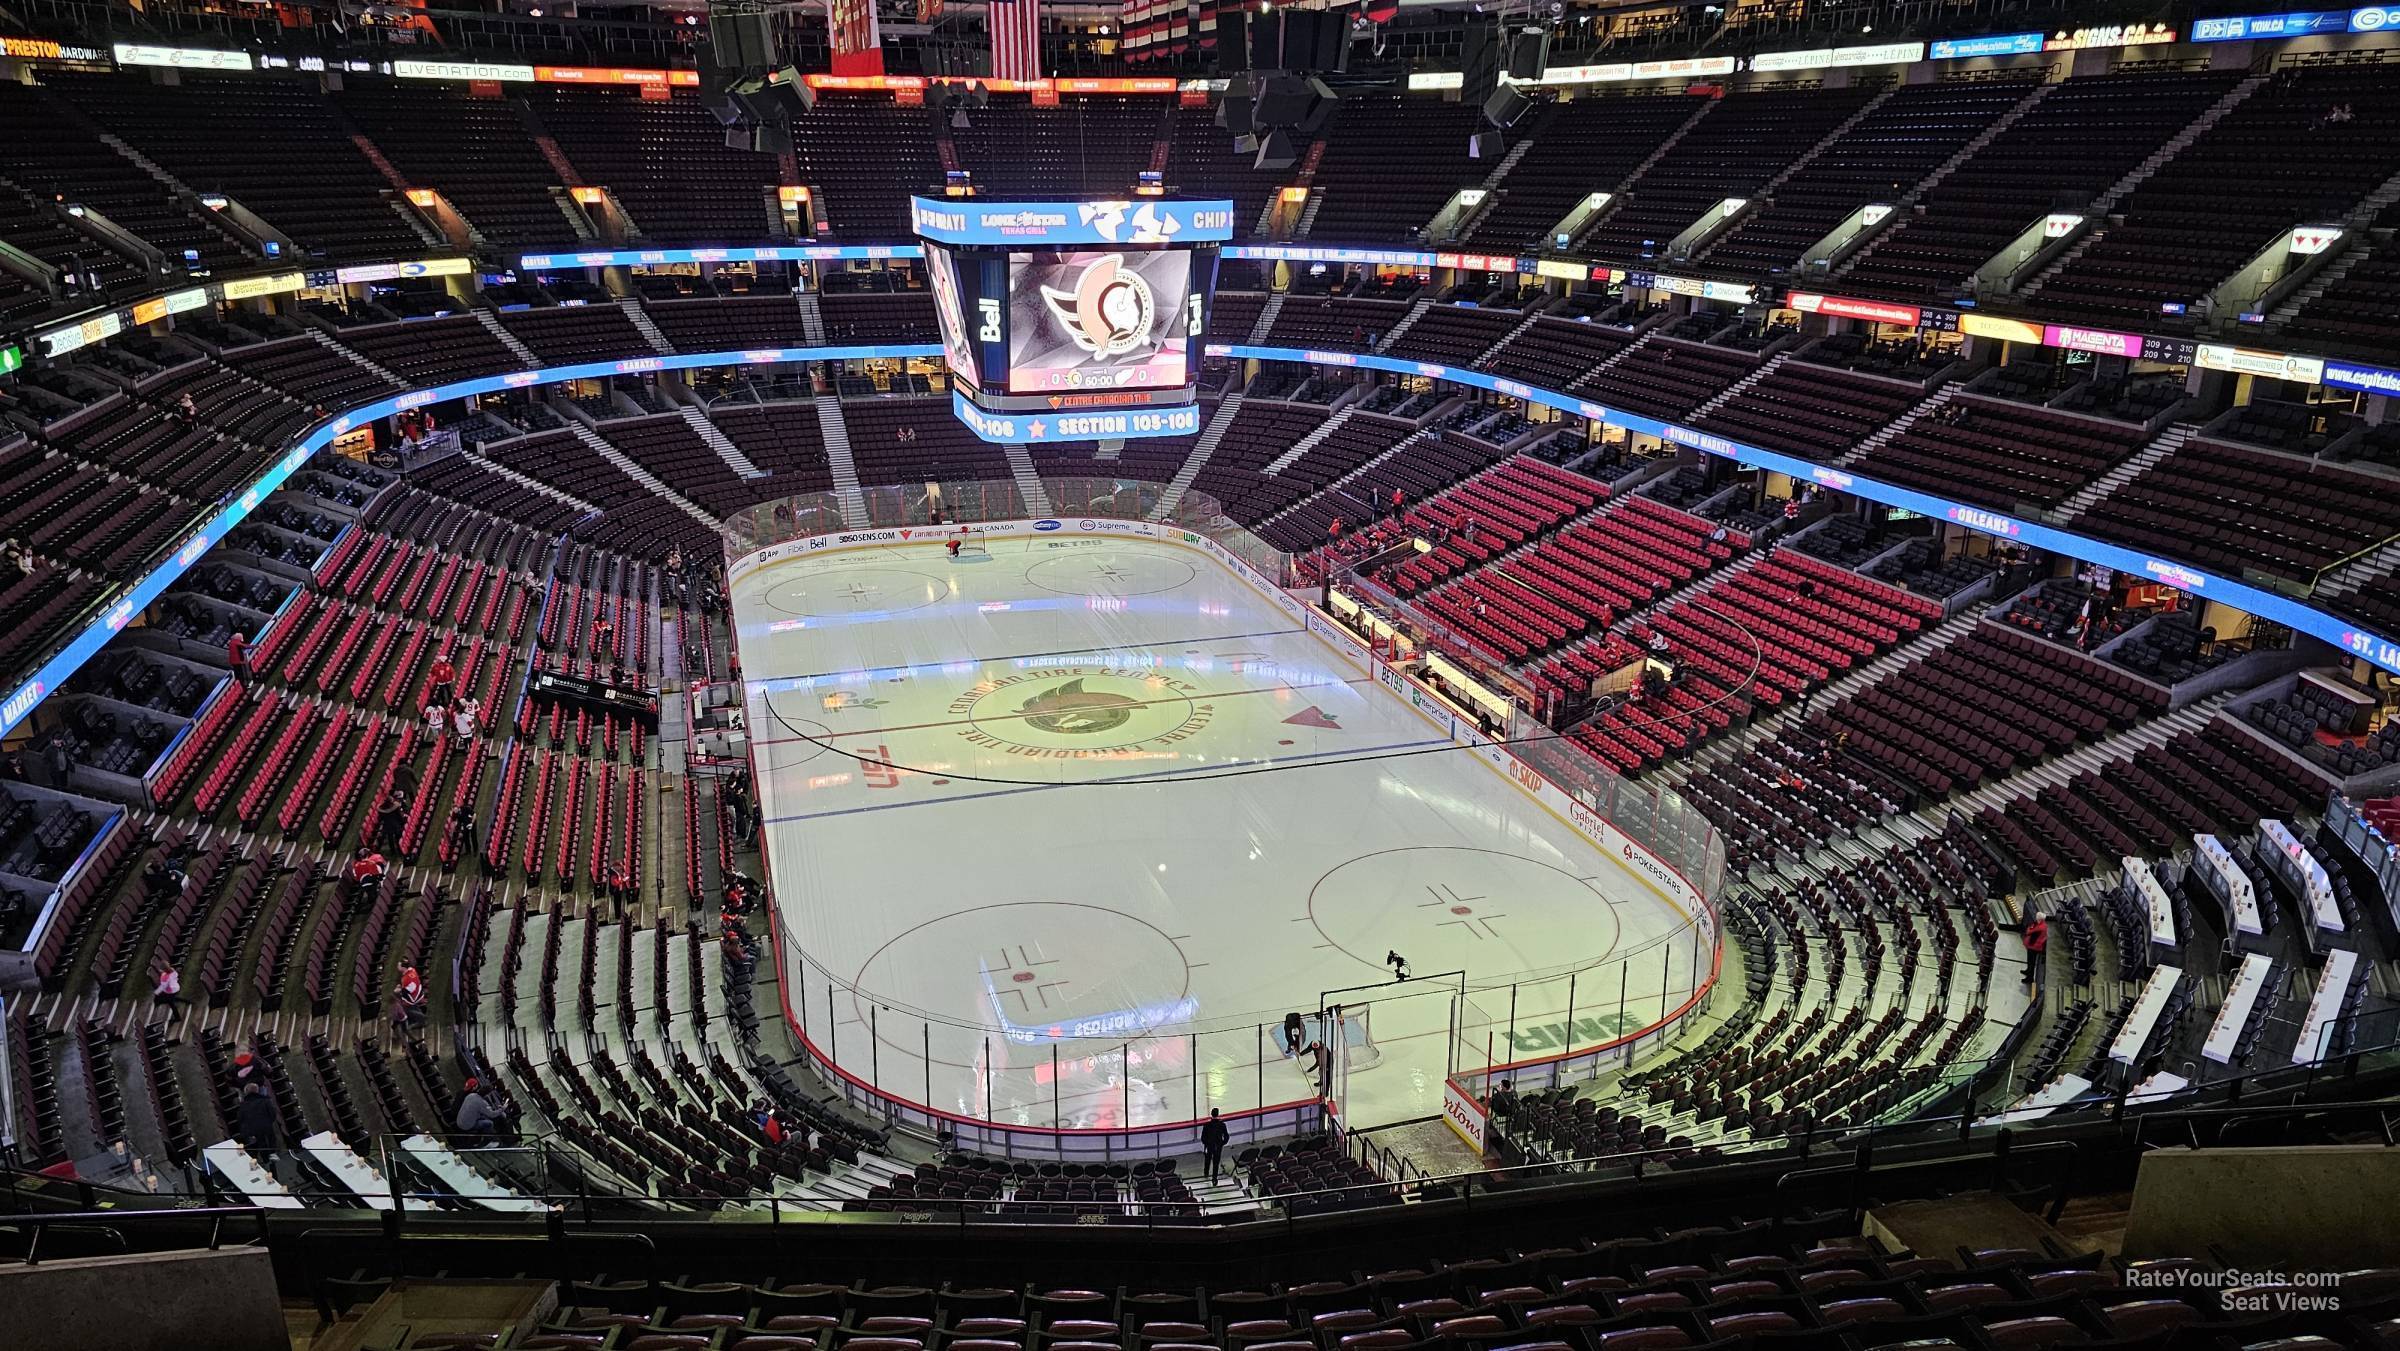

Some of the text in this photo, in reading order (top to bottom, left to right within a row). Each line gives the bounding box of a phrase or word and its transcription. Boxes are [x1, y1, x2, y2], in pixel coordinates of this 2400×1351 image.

[2250, 19, 2284, 32] YOW.CA
[2072, 24, 2147, 48] SIGNS.CA
[979, 298, 1001, 343] Bell
[1190, 293, 1202, 337] Bell
[1944, 313, 1957, 321] 309
[1943, 322, 1956, 330] 209
[52, 331, 82, 353] Decisive
[2072, 331, 2125, 348] MAGENTA
[2145, 339, 2193, 353] 309 310
[622, 359, 656, 370] KANATA
[2143, 350, 2192, 364] 209 210
[1084, 375, 1113, 386] 60:00
[1065, 393, 1153, 407] CENTRE CANADIAN TIRE
[1058, 416, 1126, 435] SECTION
[1669, 427, 1732, 455] BYWARD MARKET
[984, 524, 1015, 532] CANADA
[1098, 521, 1130, 531] Supreme
[1957, 507, 2009, 533] ORLEANS
[810, 537, 827, 549] Bell
[1167, 529, 1201, 545] SUBWAY
[787, 545, 804, 554] Fibe
[2019, 544, 2030, 552] 107
[2180, 591, 2193, 600] 108
[2352, 633, 2374, 657] ST.
[1381, 665, 1404, 694] BET99
[948, 676, 1024, 715] CANADIAN
[1028, 667, 1082, 678] TIRE
[3, 682, 38, 726] MARKET
[958, 730, 1003, 749] TIRE
[1164, 711, 1213, 746] CENTRE
[1519, 765, 1542, 793] SKIP
[1570, 801, 1605, 836] Gabriel
[1579, 822, 1604, 844] PIZZA
[1633, 852, 1681, 894] POKERSTARS
